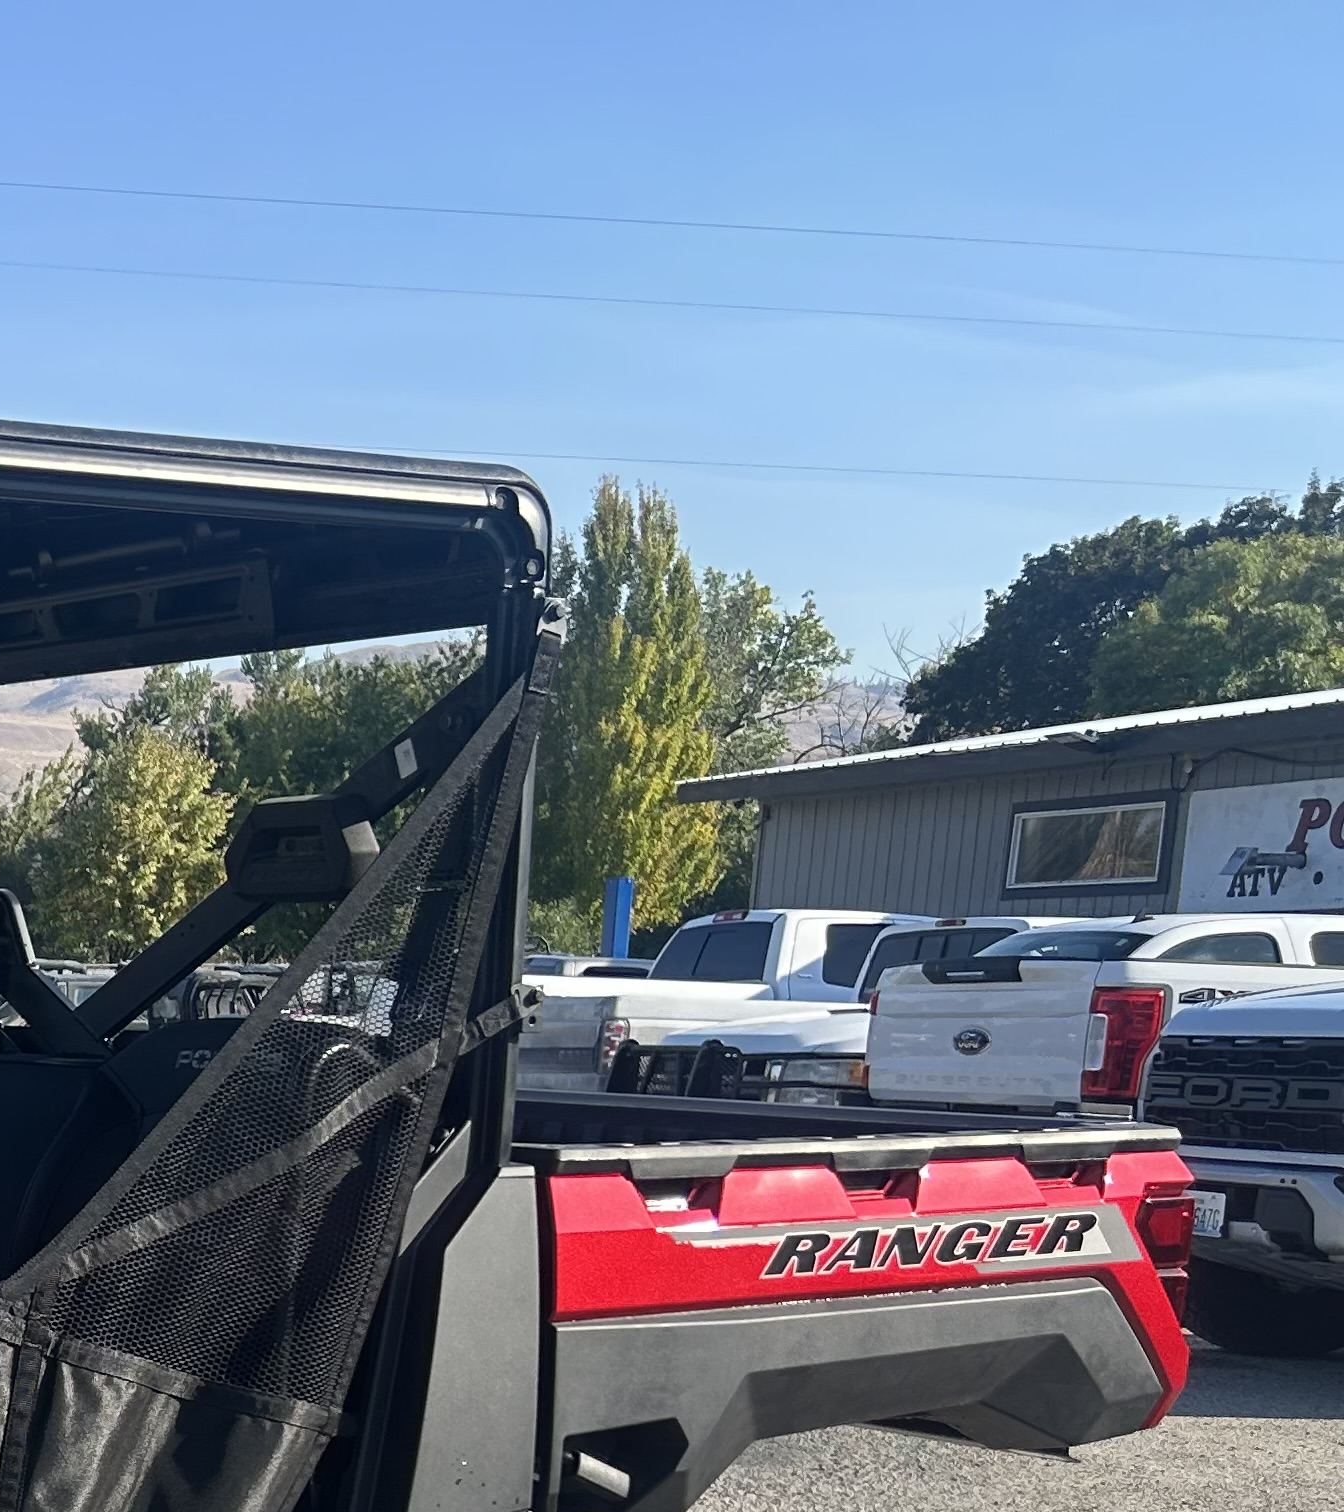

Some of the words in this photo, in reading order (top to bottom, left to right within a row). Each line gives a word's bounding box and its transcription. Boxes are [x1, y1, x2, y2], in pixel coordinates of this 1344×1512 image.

[1226, 866, 1288, 898] ATV
[1148, 1075, 1344, 1111] FORD
[758, 1211, 1100, 1280] RANGER
